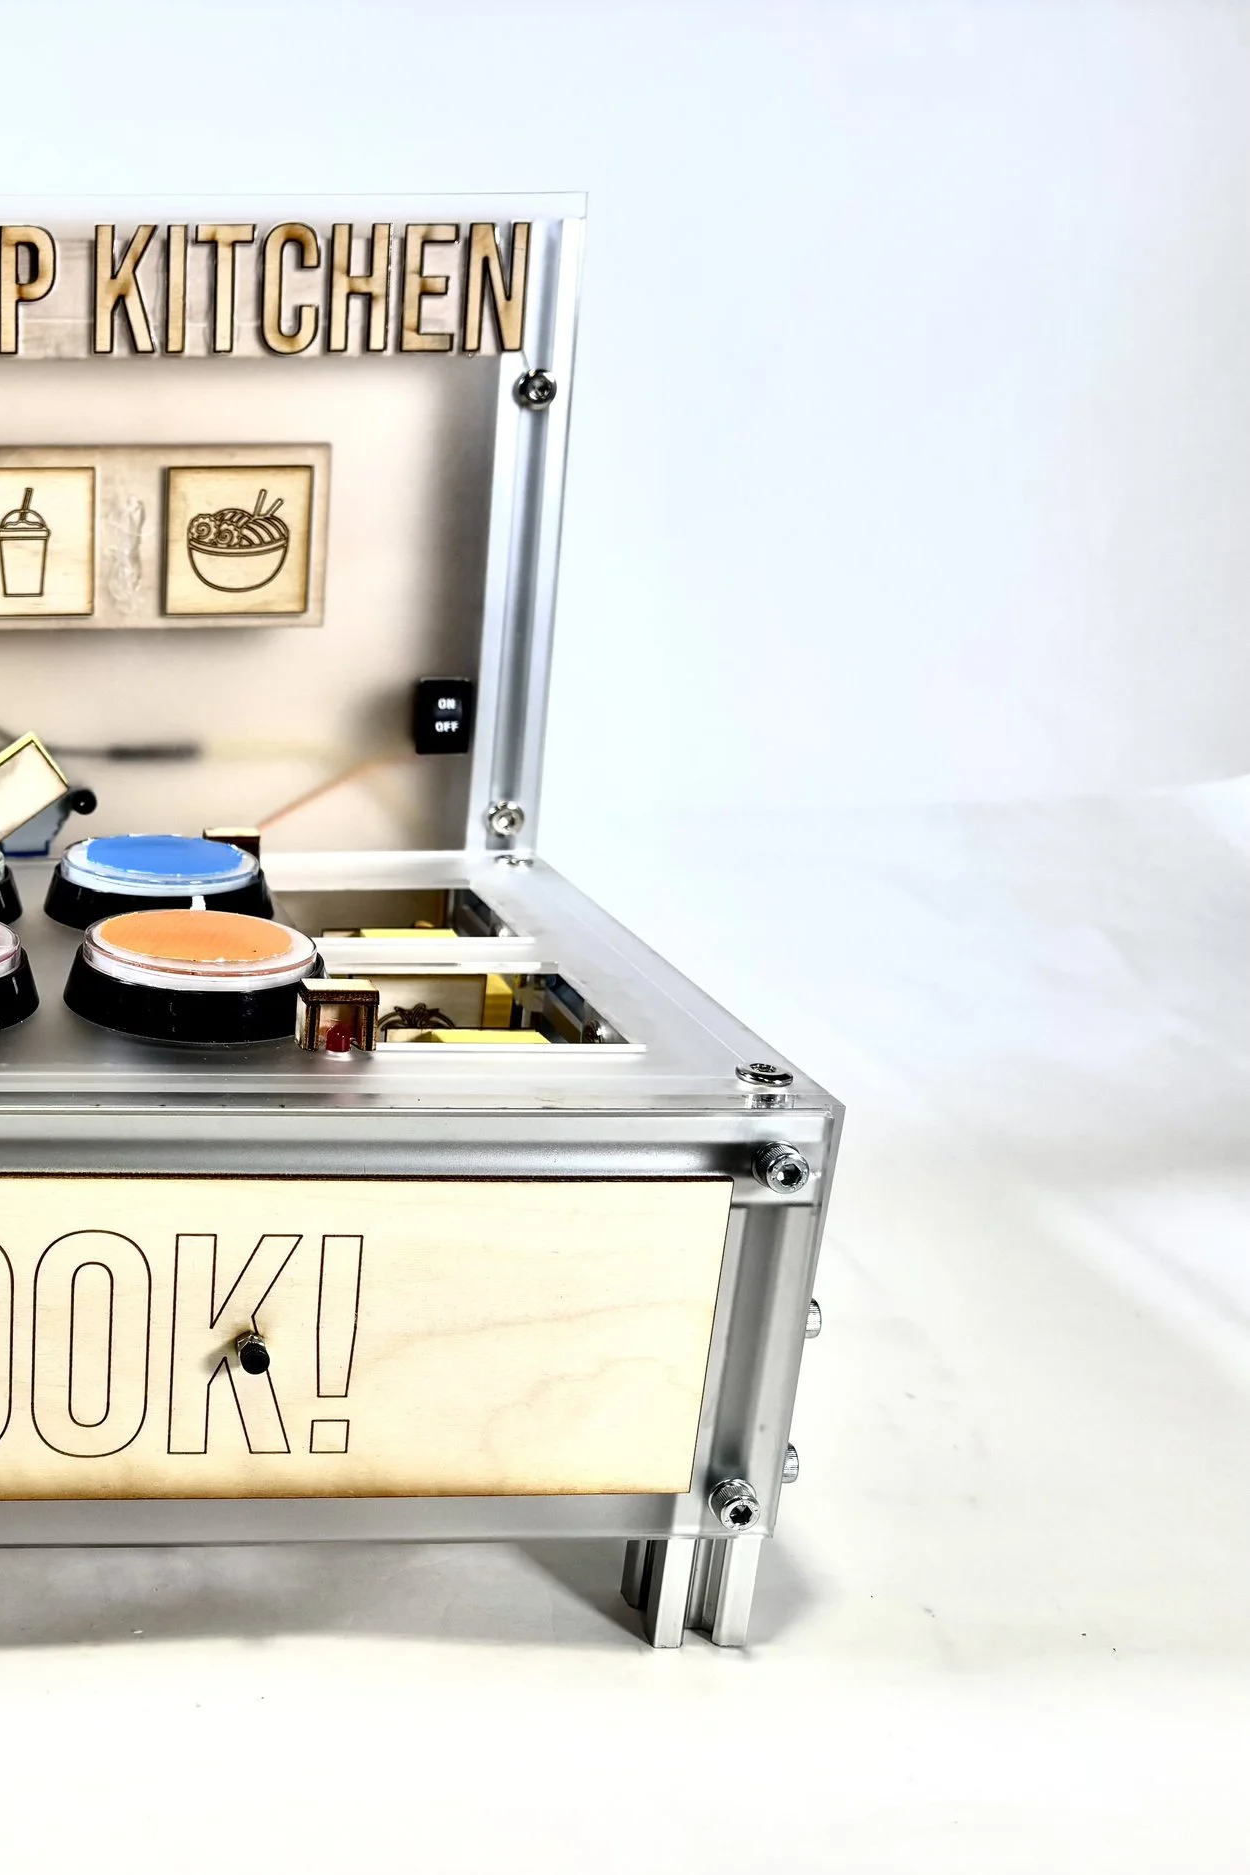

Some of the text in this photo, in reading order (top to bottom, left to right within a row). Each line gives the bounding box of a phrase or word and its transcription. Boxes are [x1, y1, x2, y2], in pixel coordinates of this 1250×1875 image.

[92, 222, 533, 354] KITCHEN
[437, 697, 456, 710] ON
[434, 720, 460, 733] OFF
